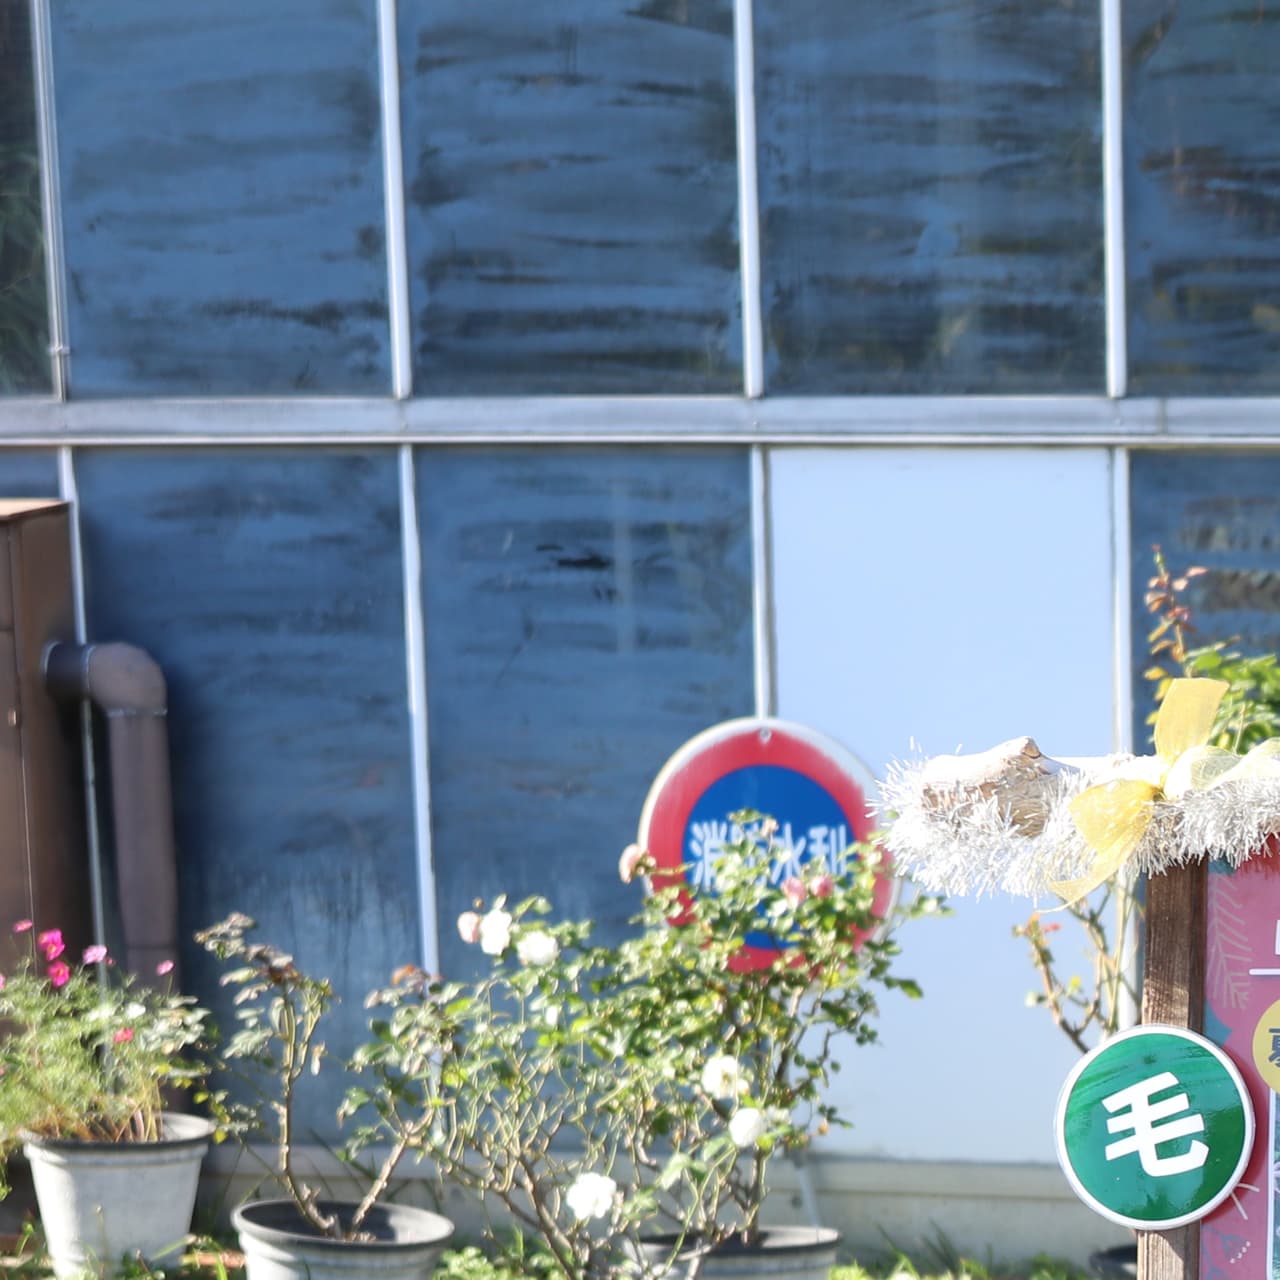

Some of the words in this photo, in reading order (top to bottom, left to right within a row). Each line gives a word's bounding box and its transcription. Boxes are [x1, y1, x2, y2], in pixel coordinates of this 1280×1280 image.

[689, 820, 848, 890] 消水利
[1103, 1071, 1210, 1178] 毛
